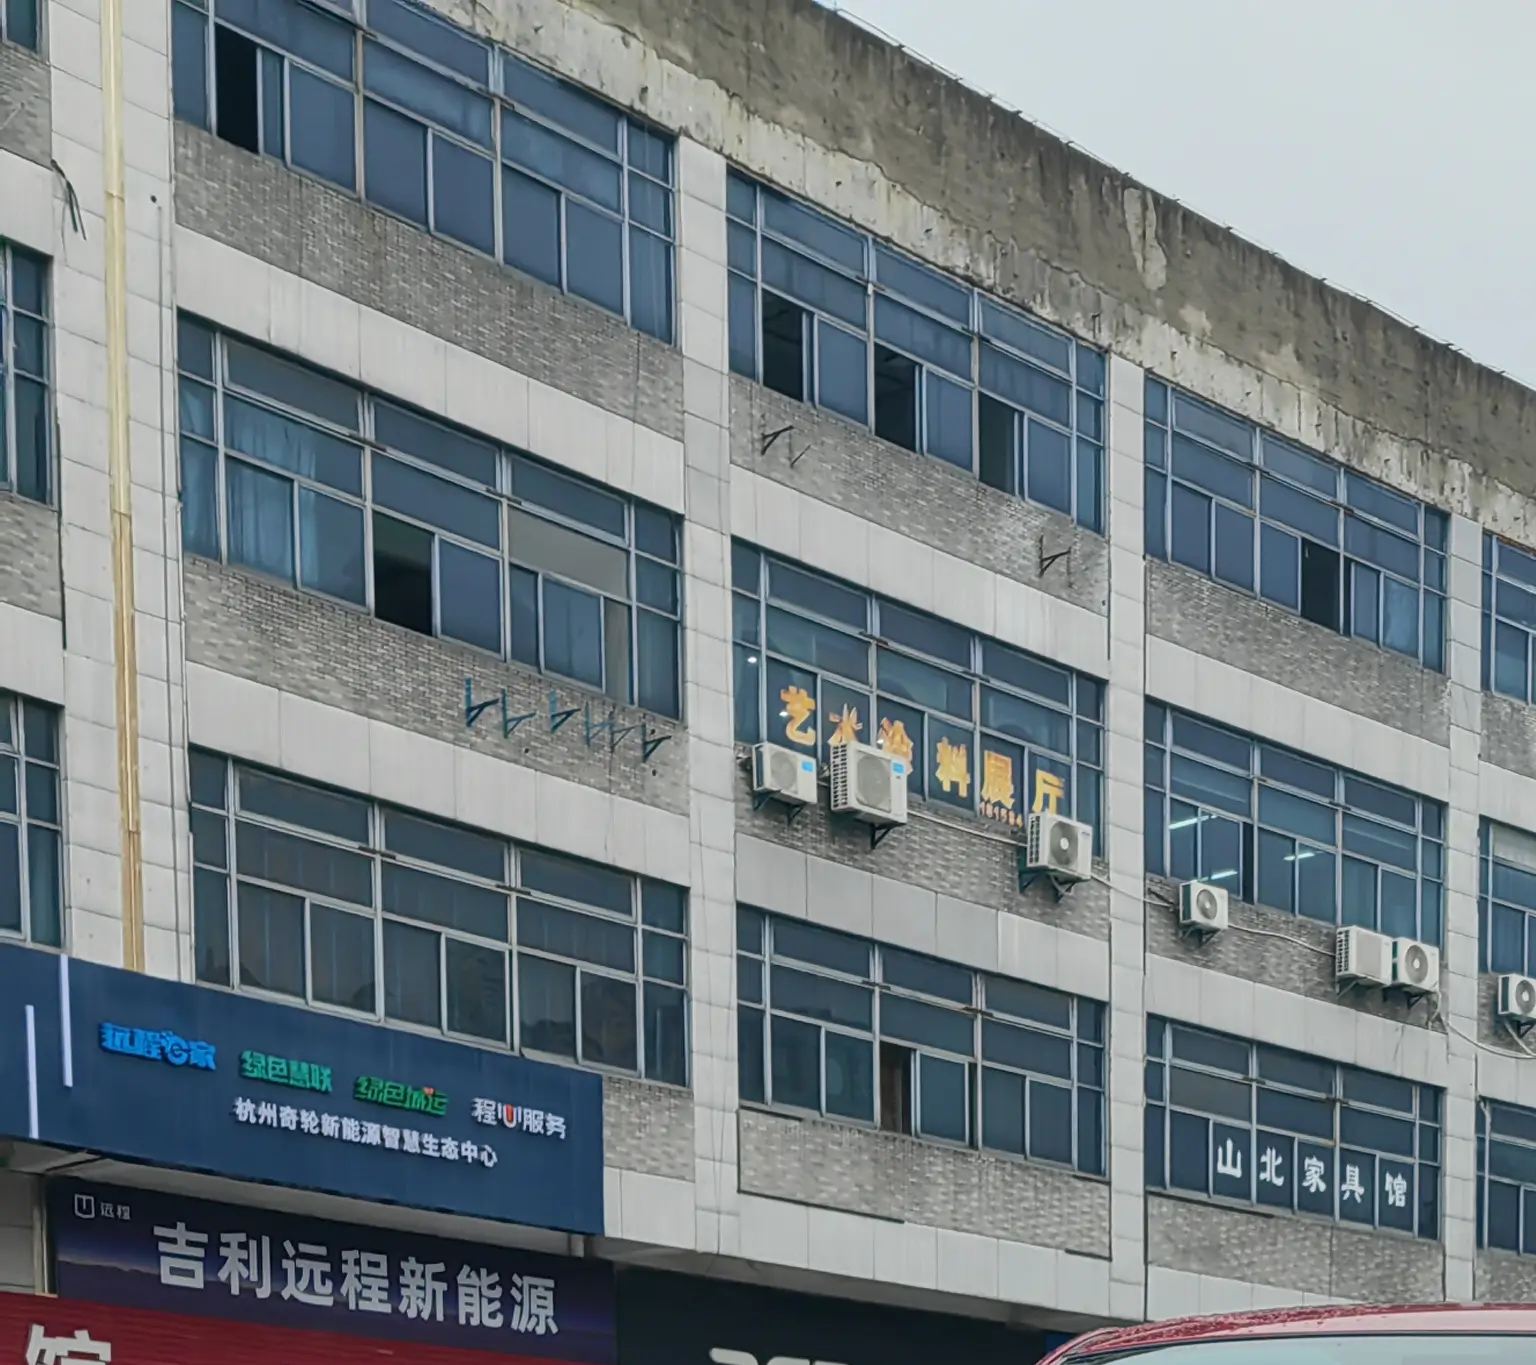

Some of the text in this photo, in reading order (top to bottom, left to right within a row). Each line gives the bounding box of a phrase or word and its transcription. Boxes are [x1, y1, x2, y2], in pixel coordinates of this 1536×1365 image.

[234, 1097, 498, 1169] 杭州奇轮新能源智慧生态中心
[1217, 1138, 1407, 1208] 山北家具馆
[152, 1221, 561, 1337] 吉利远程新能源
